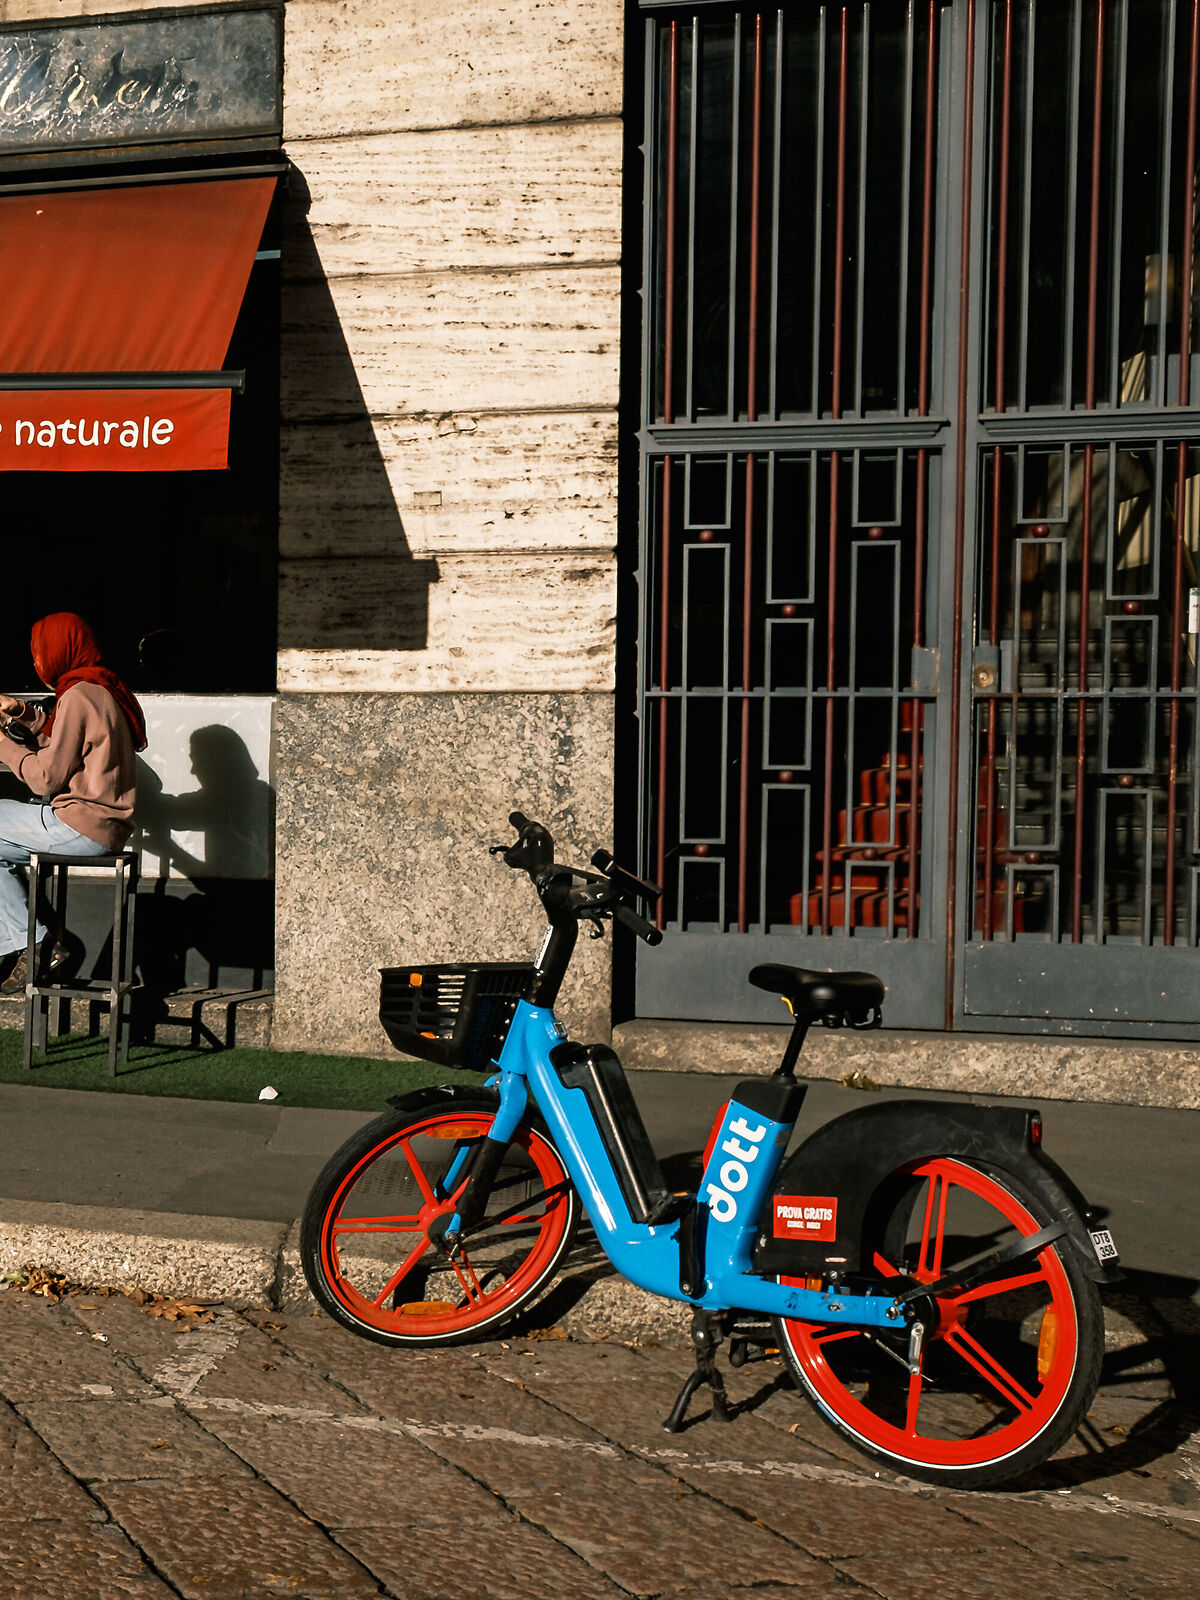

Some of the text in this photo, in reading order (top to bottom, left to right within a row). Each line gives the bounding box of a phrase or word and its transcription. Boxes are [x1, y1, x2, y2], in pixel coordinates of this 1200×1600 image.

[15, 415, 175, 448] naturale
[706, 1117, 767, 1222] dott
[777, 1206, 832, 1220] PROVA GRATIS
[1093, 1232, 1110, 1244] DT8
[1100, 1245, 1115, 1257] 358
